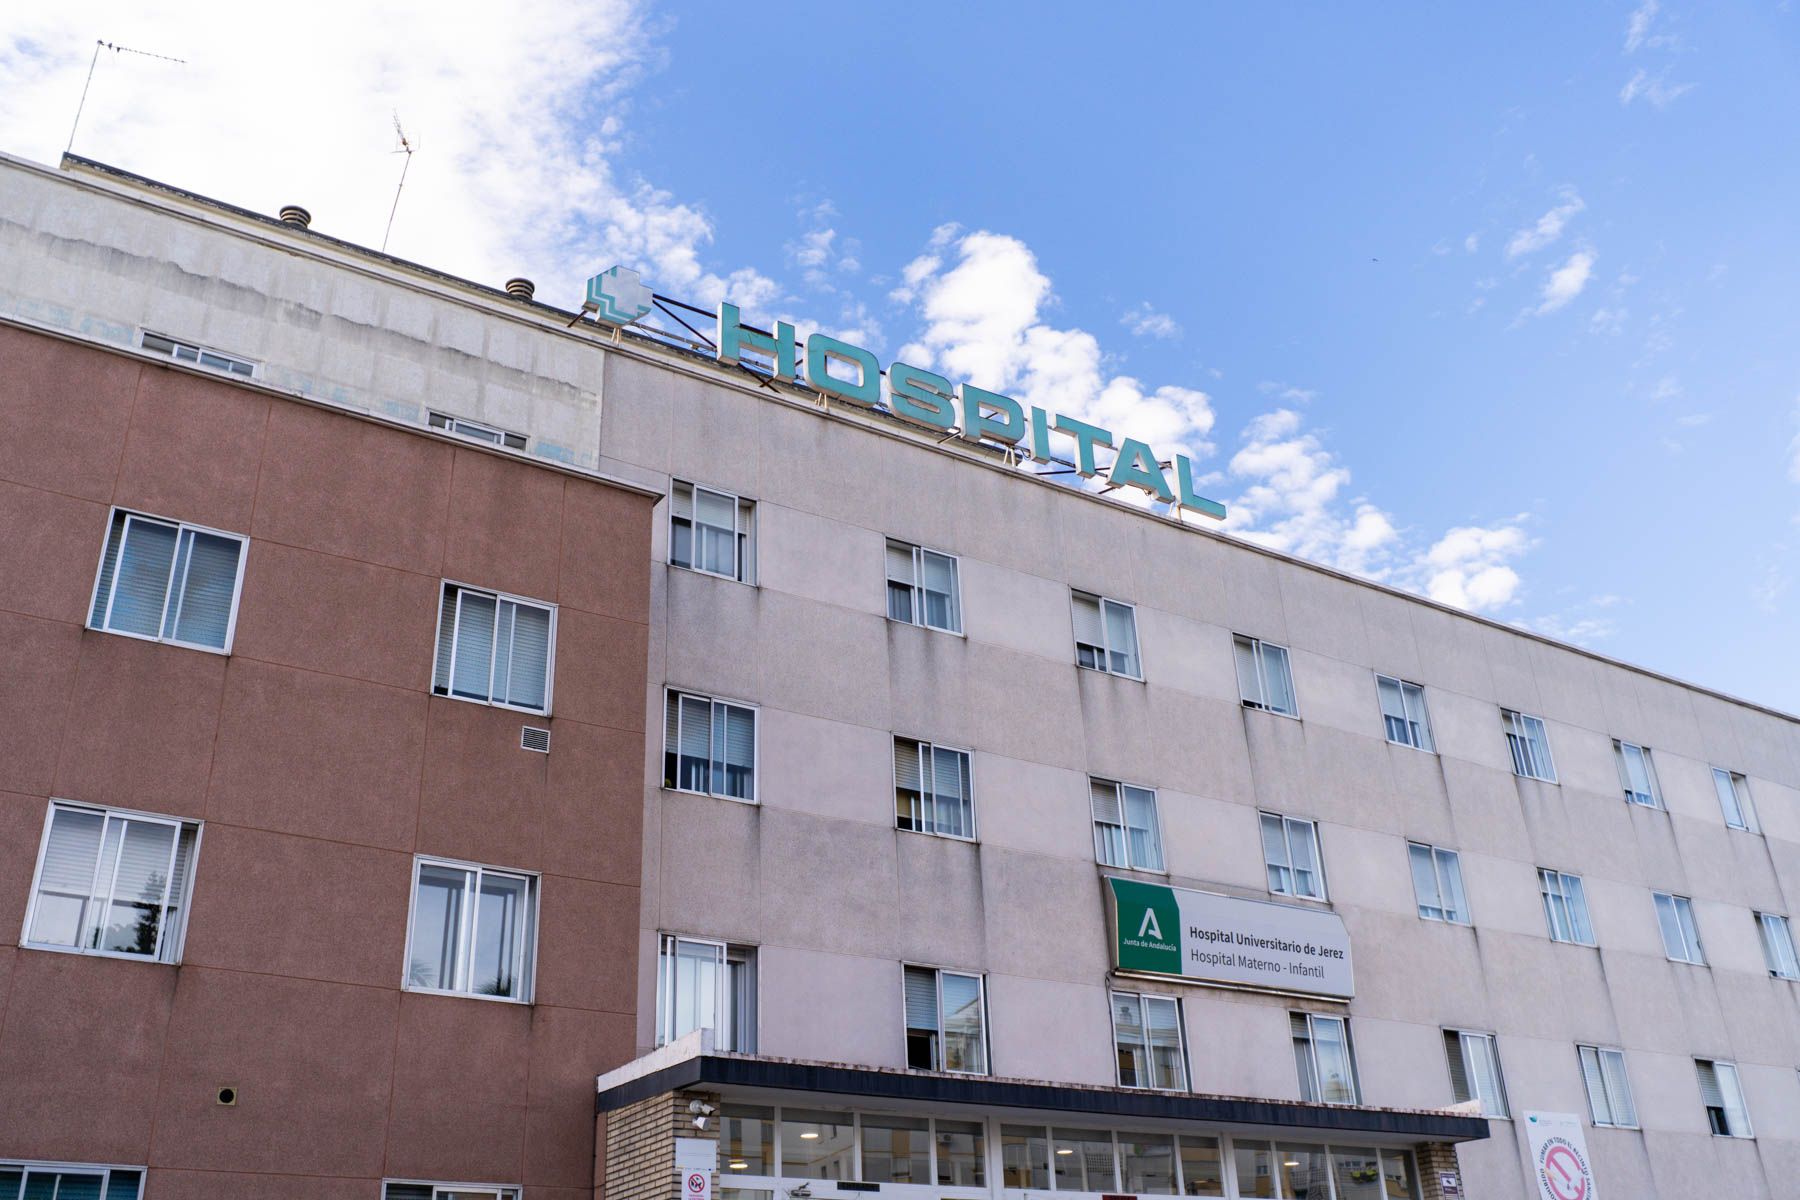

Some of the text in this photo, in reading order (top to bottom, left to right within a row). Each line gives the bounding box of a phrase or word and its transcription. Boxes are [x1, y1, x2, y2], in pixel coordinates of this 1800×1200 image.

[715, 301, 1227, 521] HOSPITAL
[1123, 937, 1177, 952] Junta de Andalucía
[1190, 926, 1344, 960] Hospital Universitario de Jerez
[1191, 948, 1236, 967] Hospital
[1238, 955, 1281, 973] Materno
[1289, 962, 1325, 979] Infantil
